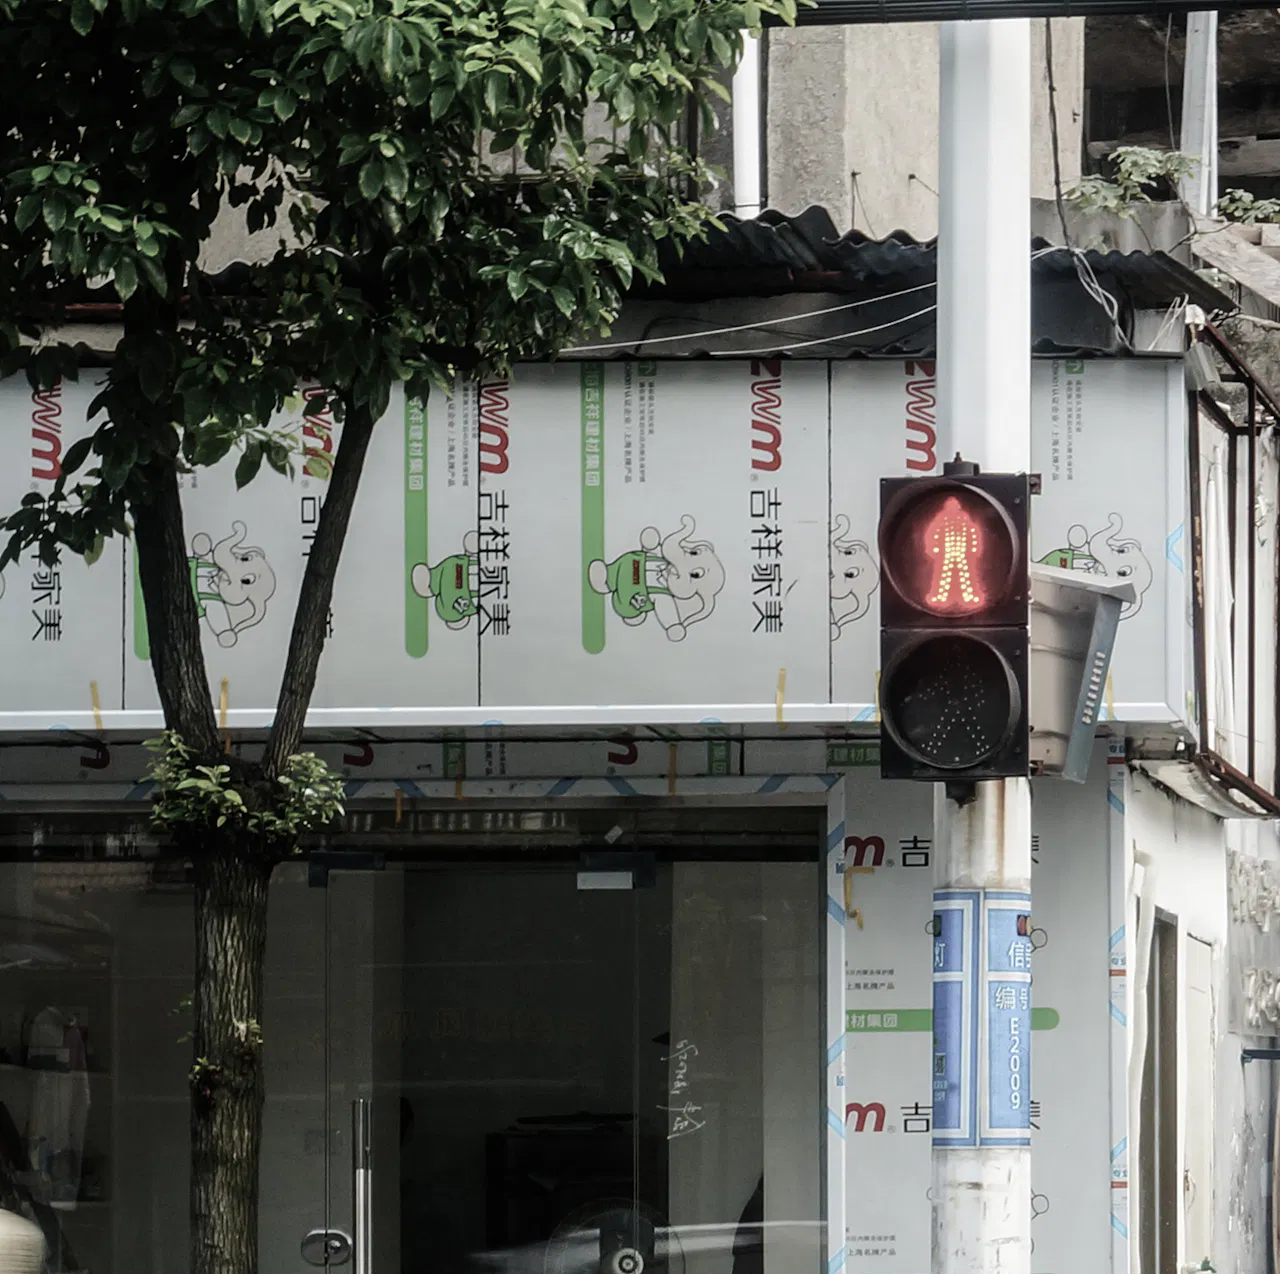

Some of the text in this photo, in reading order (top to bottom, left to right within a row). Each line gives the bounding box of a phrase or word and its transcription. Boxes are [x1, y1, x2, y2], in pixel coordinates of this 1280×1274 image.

[31, 376, 62, 480] wm
[480, 378, 510, 637] wm 吉祥家美
[751, 486, 783, 634] 吉祥家美
[995, 986, 1029, 1010] 编号
[1009, 1016, 1021, 1110] E2009
